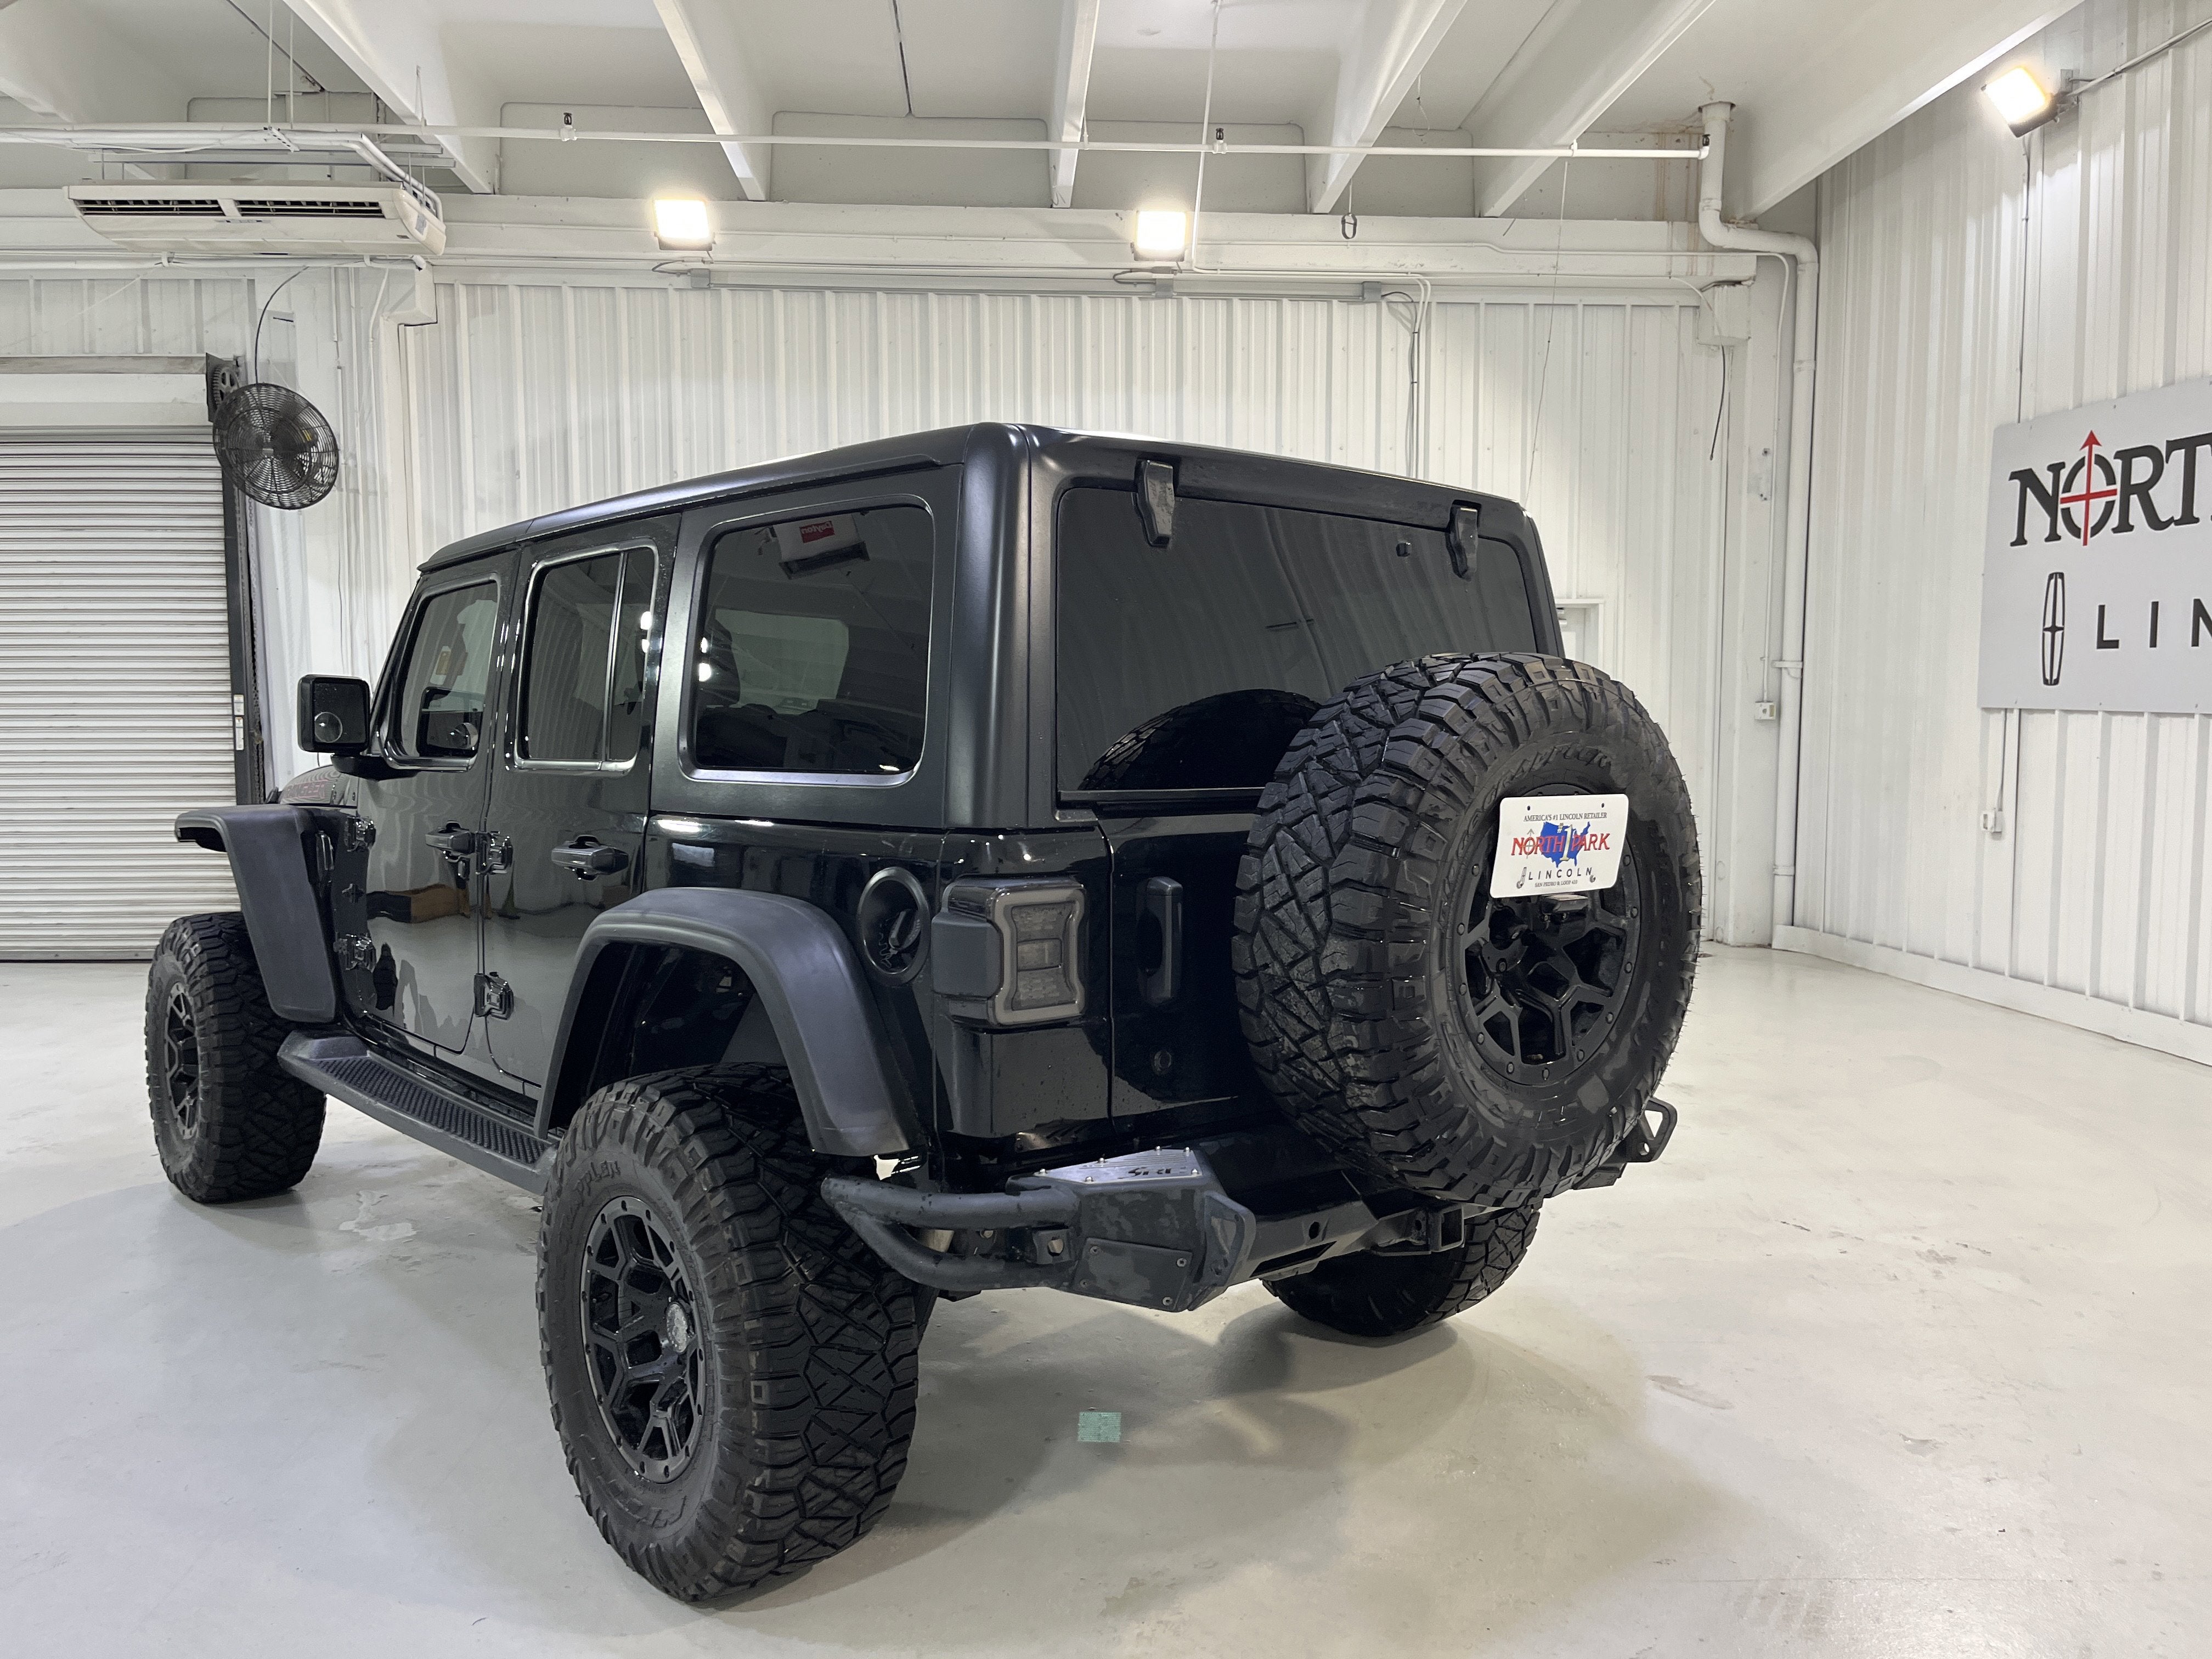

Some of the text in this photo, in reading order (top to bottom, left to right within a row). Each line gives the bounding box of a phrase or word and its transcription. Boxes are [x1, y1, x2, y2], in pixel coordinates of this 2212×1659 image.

[2008, 432, 2212, 546] NORT
[1511, 833, 1610, 856] NORTH PARK
[1528, 867, 1593, 881] LINCOLN
